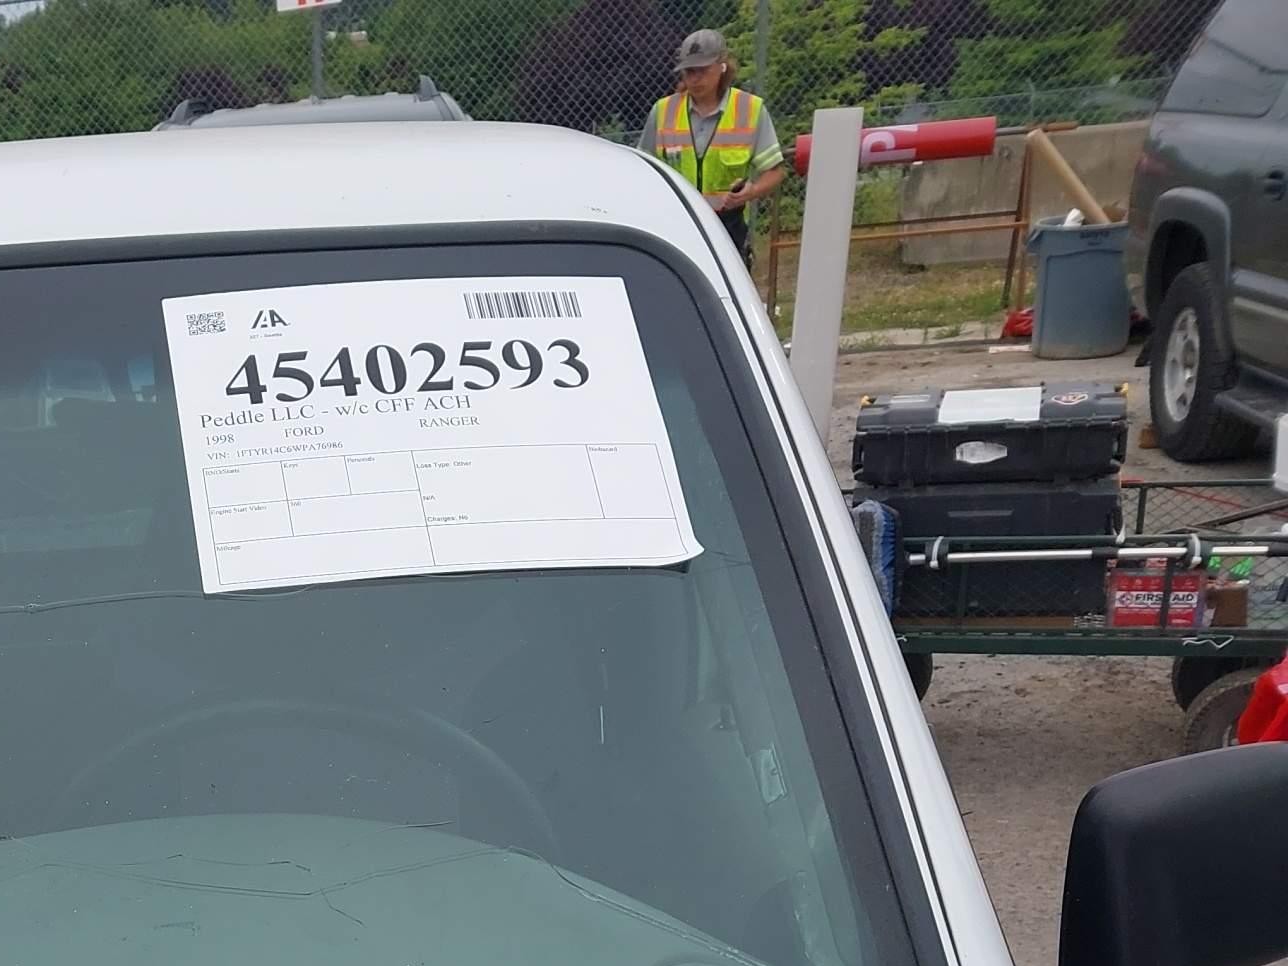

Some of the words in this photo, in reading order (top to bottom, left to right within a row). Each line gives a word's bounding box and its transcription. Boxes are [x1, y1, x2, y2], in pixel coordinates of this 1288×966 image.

[225, 338, 590, 405] 45402593
[200, 408, 265, 428] Peddle
[271, 404, 315, 422] LLC
[335, 400, 369, 416] w/c
[375, 398, 416, 414] CFF
[424, 395, 472, 411] ACH
[205, 433, 235, 446] 1998
[284, 425, 325, 438] FORD
[418, 416, 480, 428] RANGER
[207, 451, 230, 461] VIN:
[1135, 593, 1163, 602] FIRS
[1172, 594, 1195, 602] AID
